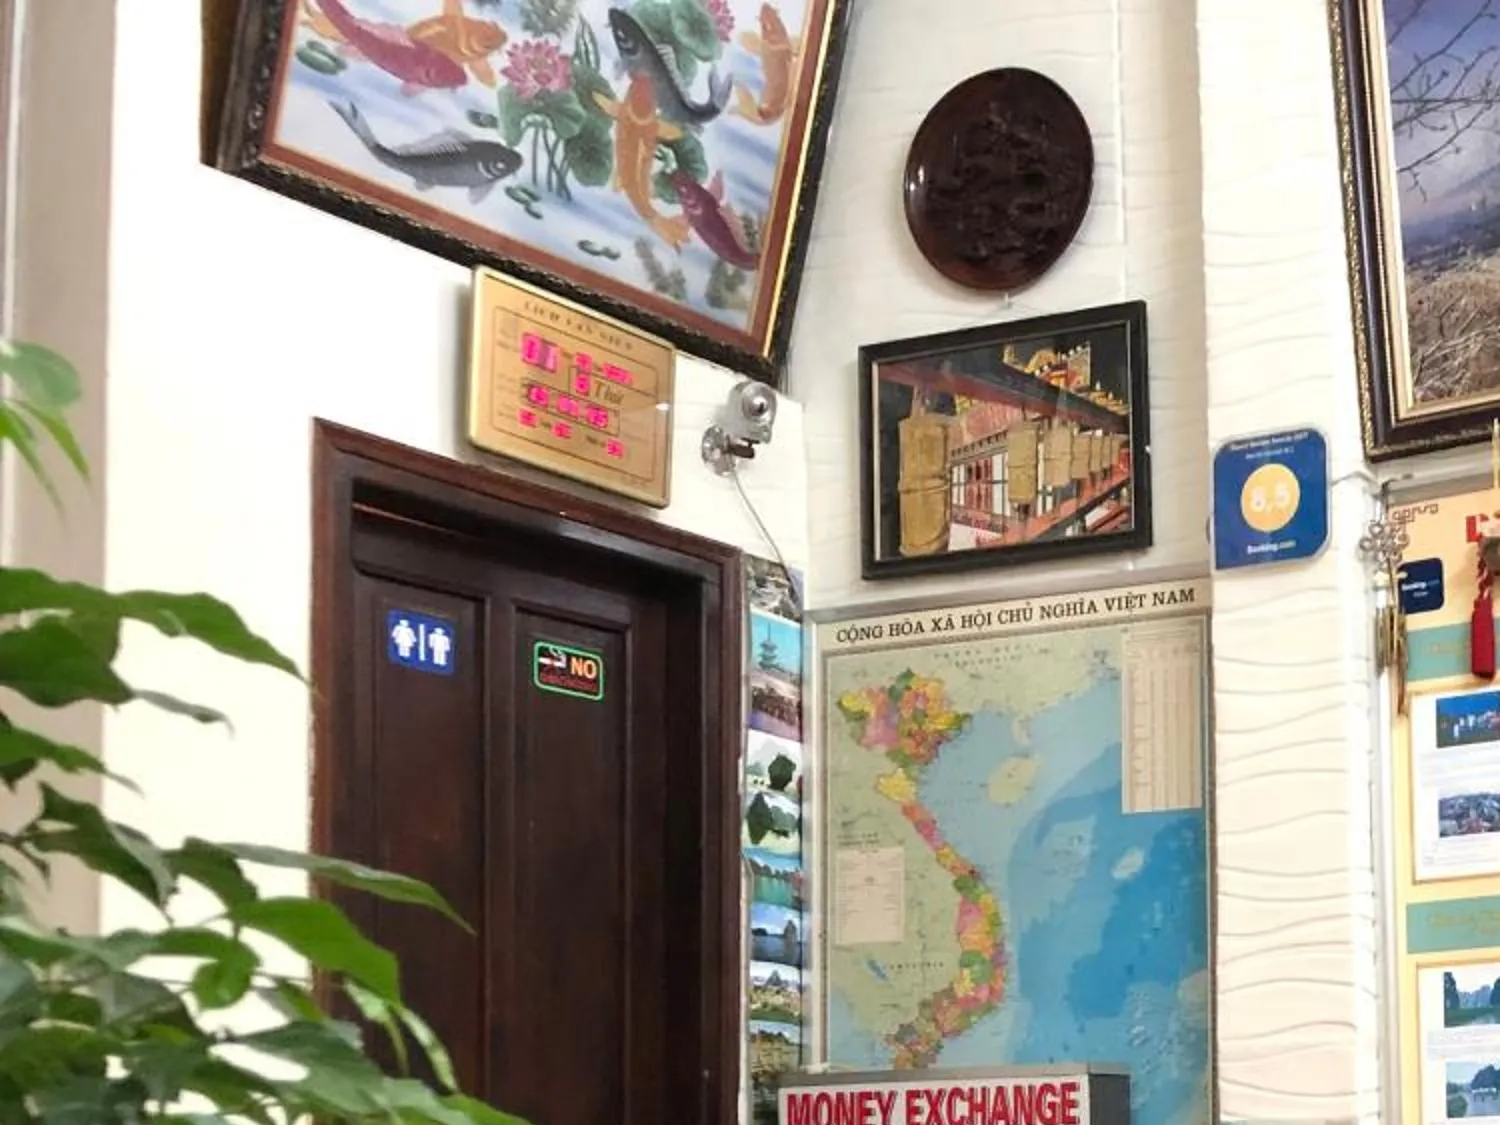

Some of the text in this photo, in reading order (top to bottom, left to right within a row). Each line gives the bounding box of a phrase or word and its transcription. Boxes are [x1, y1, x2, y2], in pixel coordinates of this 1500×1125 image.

[836, 623, 884, 644] CỘNG
[960, 610, 992, 632] HỘI
[997, 601, 1033, 624] CHỦ
[1105, 592, 1147, 613] VIỆT
[1152, 587, 1196, 607] NAM
[571, 656, 597, 679] NO
